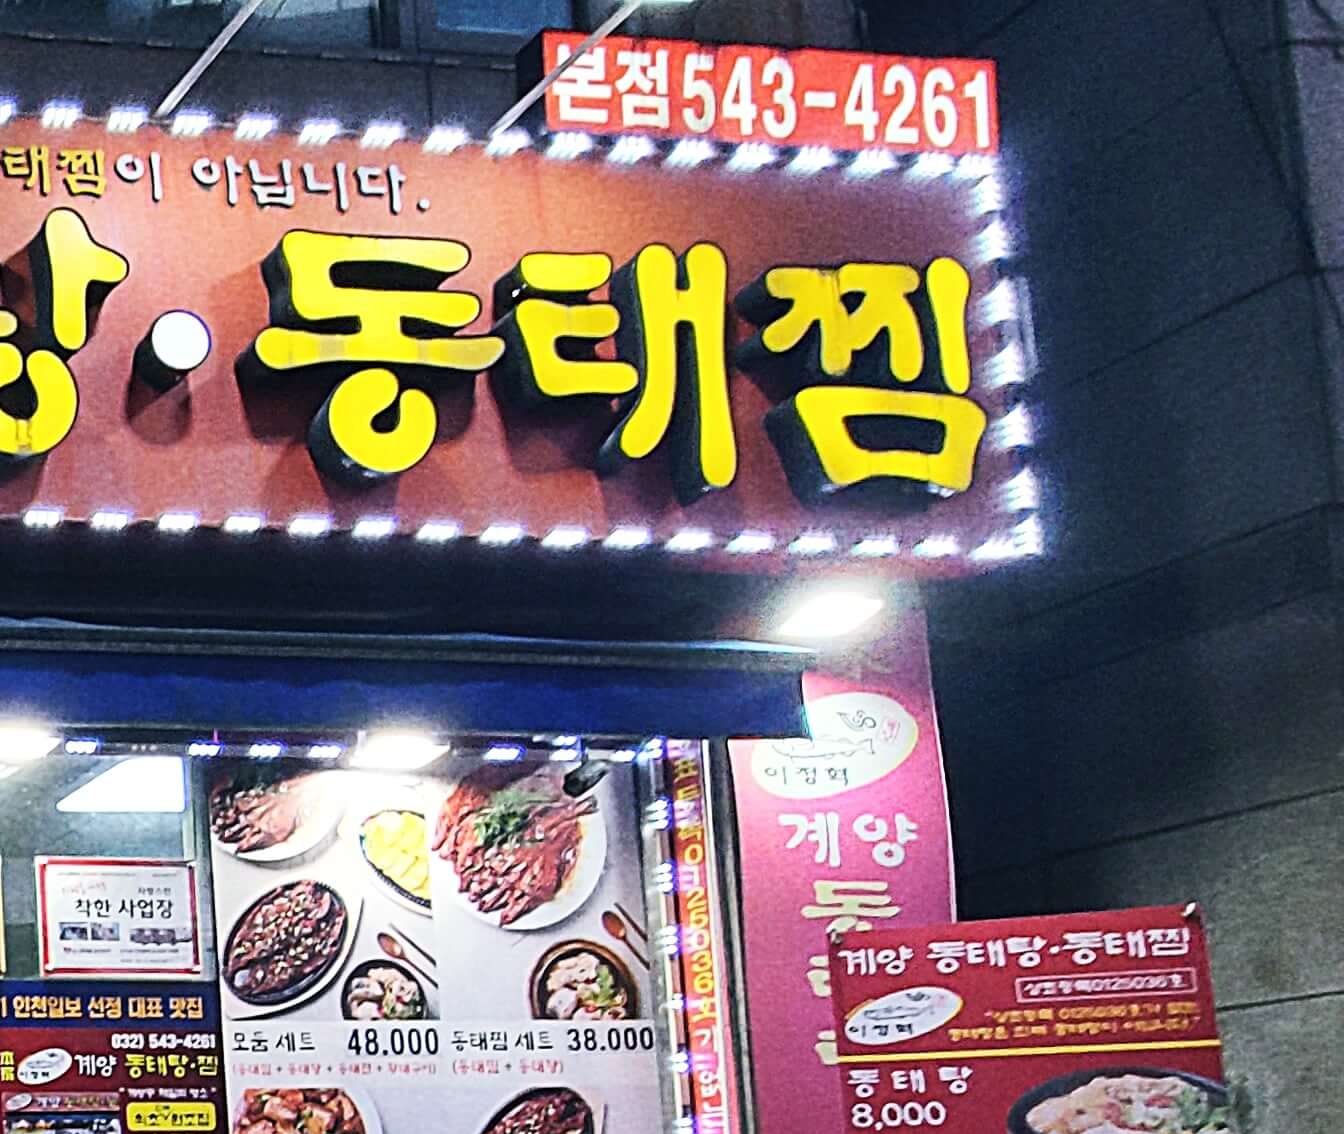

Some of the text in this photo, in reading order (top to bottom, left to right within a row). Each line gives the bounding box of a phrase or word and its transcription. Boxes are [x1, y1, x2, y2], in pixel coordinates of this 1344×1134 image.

[550, 42, 994, 152] 본점543-4261
[192, 159, 434, 214] 아닙니다.
[778, 811, 918, 868] 계양
[75, 898, 173, 919] 착한 사업장
[838, 941, 914, 977] 계양
[13, 995, 82, 1019] 인천일보
[88, 995, 123, 1019] 선정
[128, 996, 164, 1019] 대표
[169, 996, 204, 1019] 맛집
[275, 1031, 316, 1053] 세트
[450, 1029, 508, 1051] 동태찜
[514, 1030, 554, 1051] 세트
[74, 1053, 117, 1078] 계양
[850, 1101, 948, 1132] 8,000
